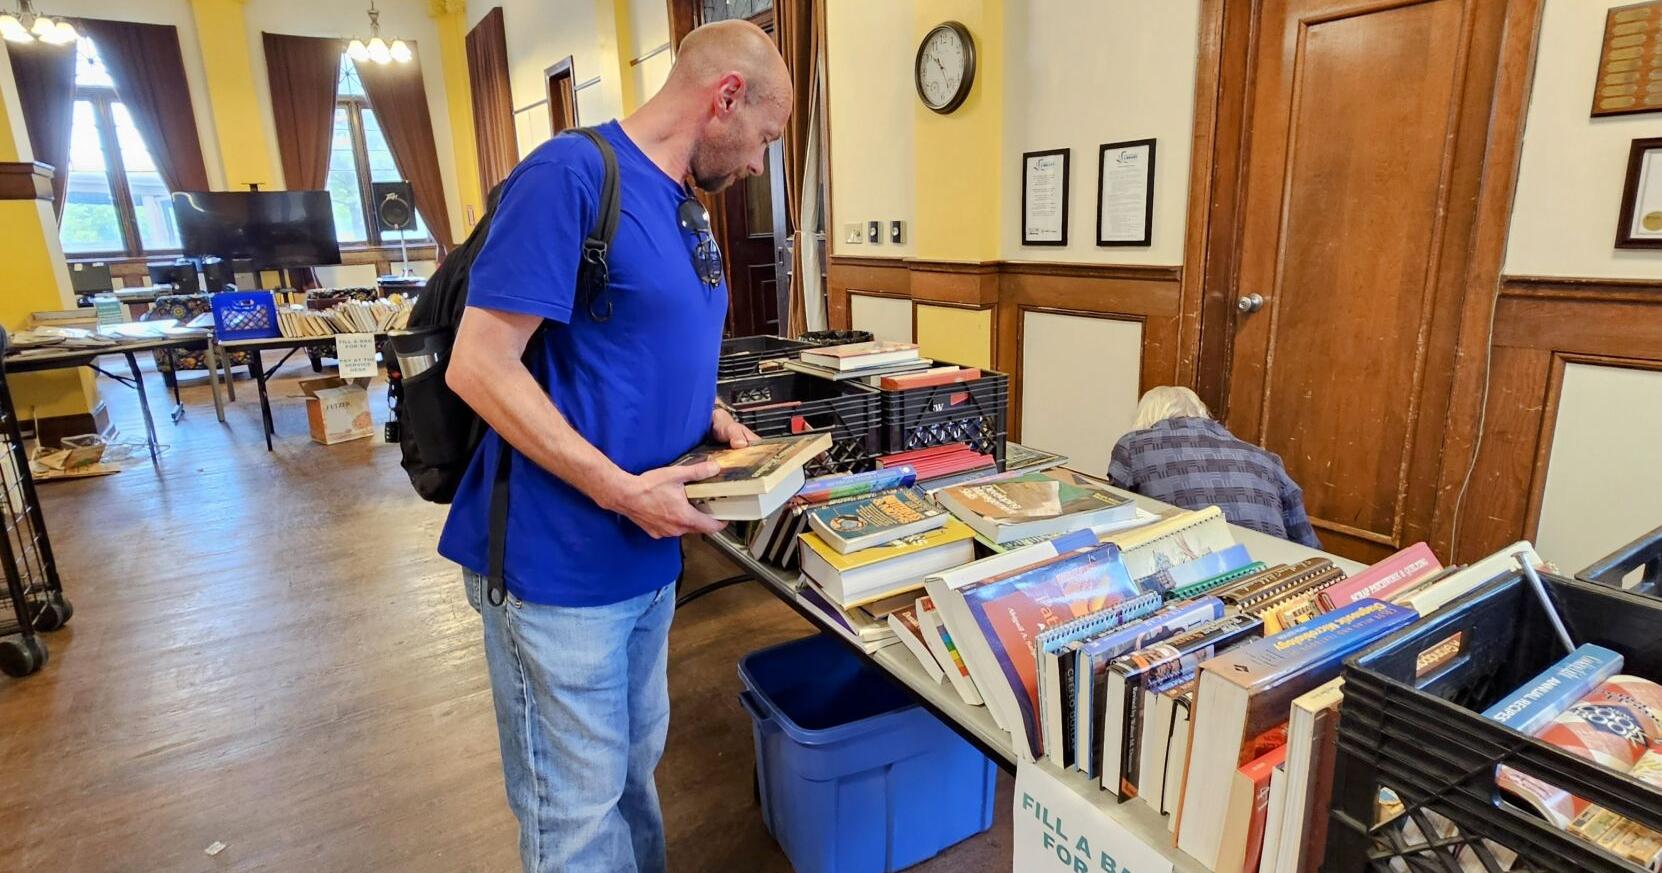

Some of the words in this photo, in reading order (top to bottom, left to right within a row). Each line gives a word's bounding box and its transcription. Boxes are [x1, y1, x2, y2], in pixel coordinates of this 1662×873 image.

[1522, 676, 1562, 701] ANNUAL
[1491, 697, 1533, 722] RECIPES
[1022, 792, 1068, 841] FILL
[1075, 835, 1092, 860] A
[1100, 851, 1131, 873] B
[1043, 832, 1088, 873] FOR
